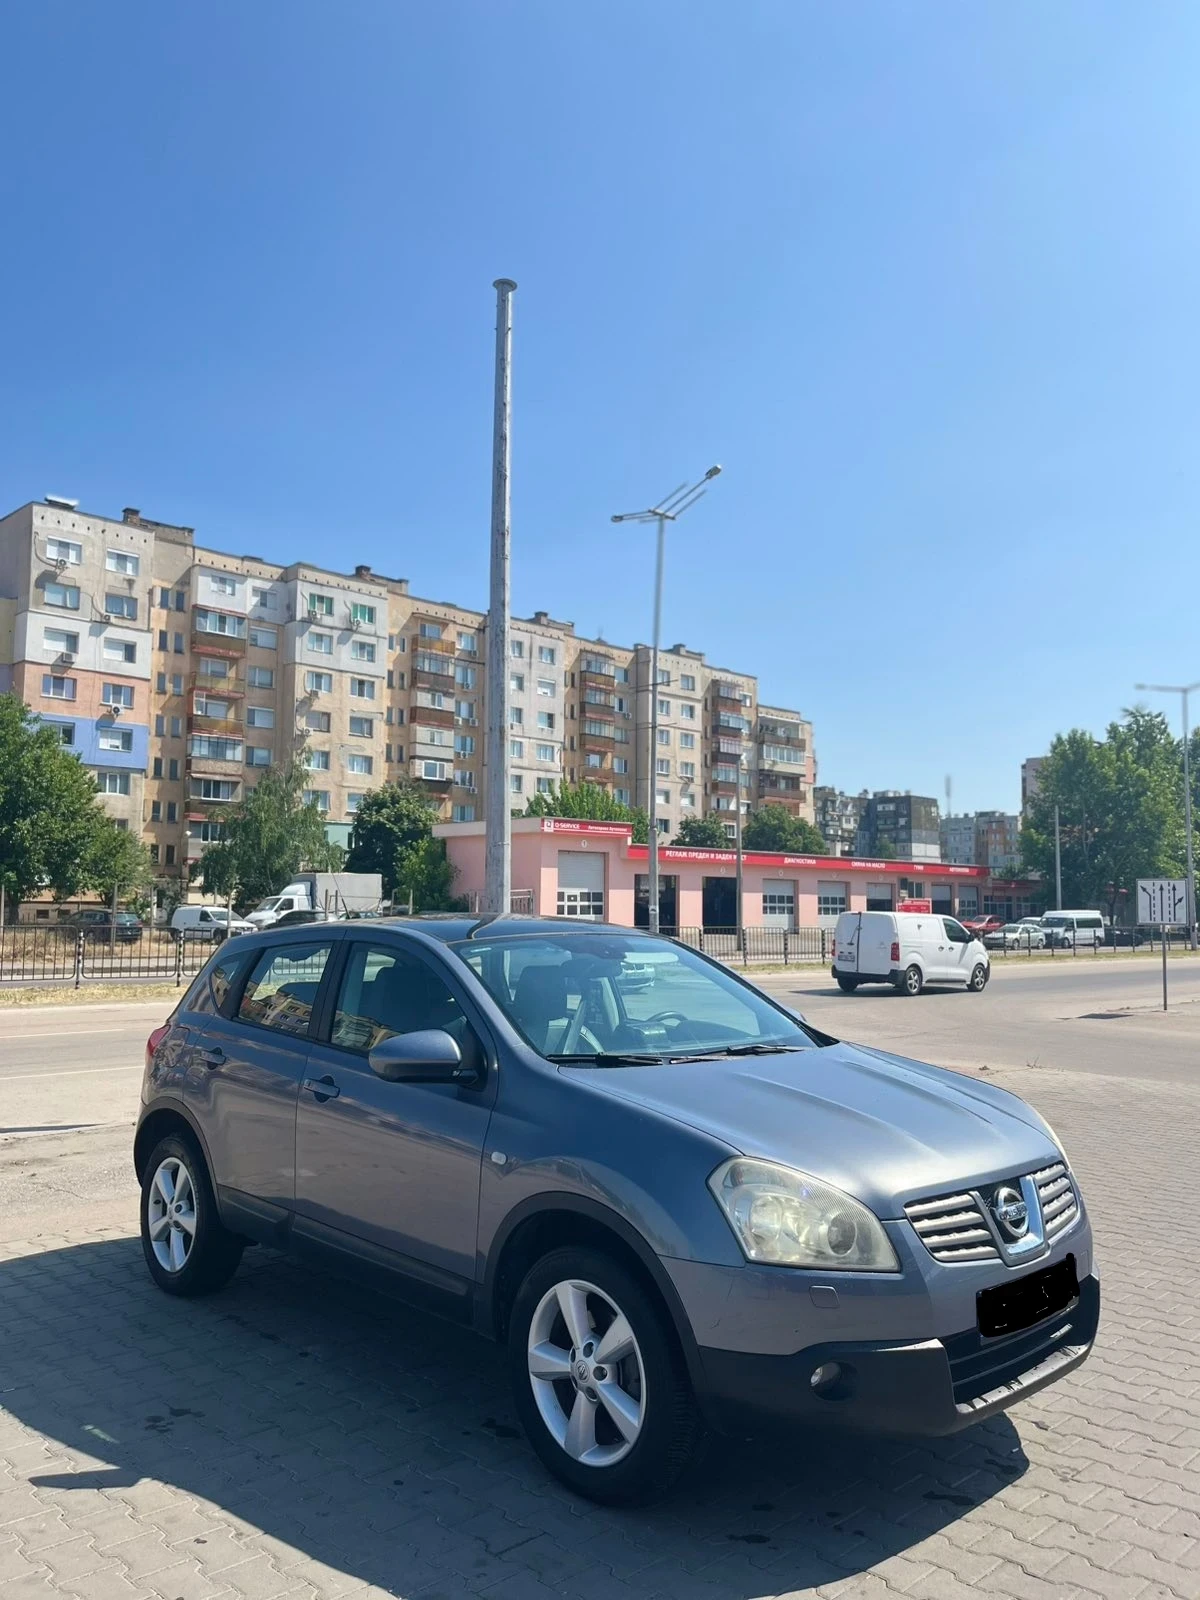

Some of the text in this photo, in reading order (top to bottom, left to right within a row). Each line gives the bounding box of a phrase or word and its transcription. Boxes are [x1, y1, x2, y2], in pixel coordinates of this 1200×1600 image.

[665, 850, 688, 858] РЕГЛАЖ
[688, 851, 710, 859] ПРЕДЕН
[715, 853, 733, 861] ЗАДЕН
[784, 857, 817, 865] ДИАГНОСТИКА
